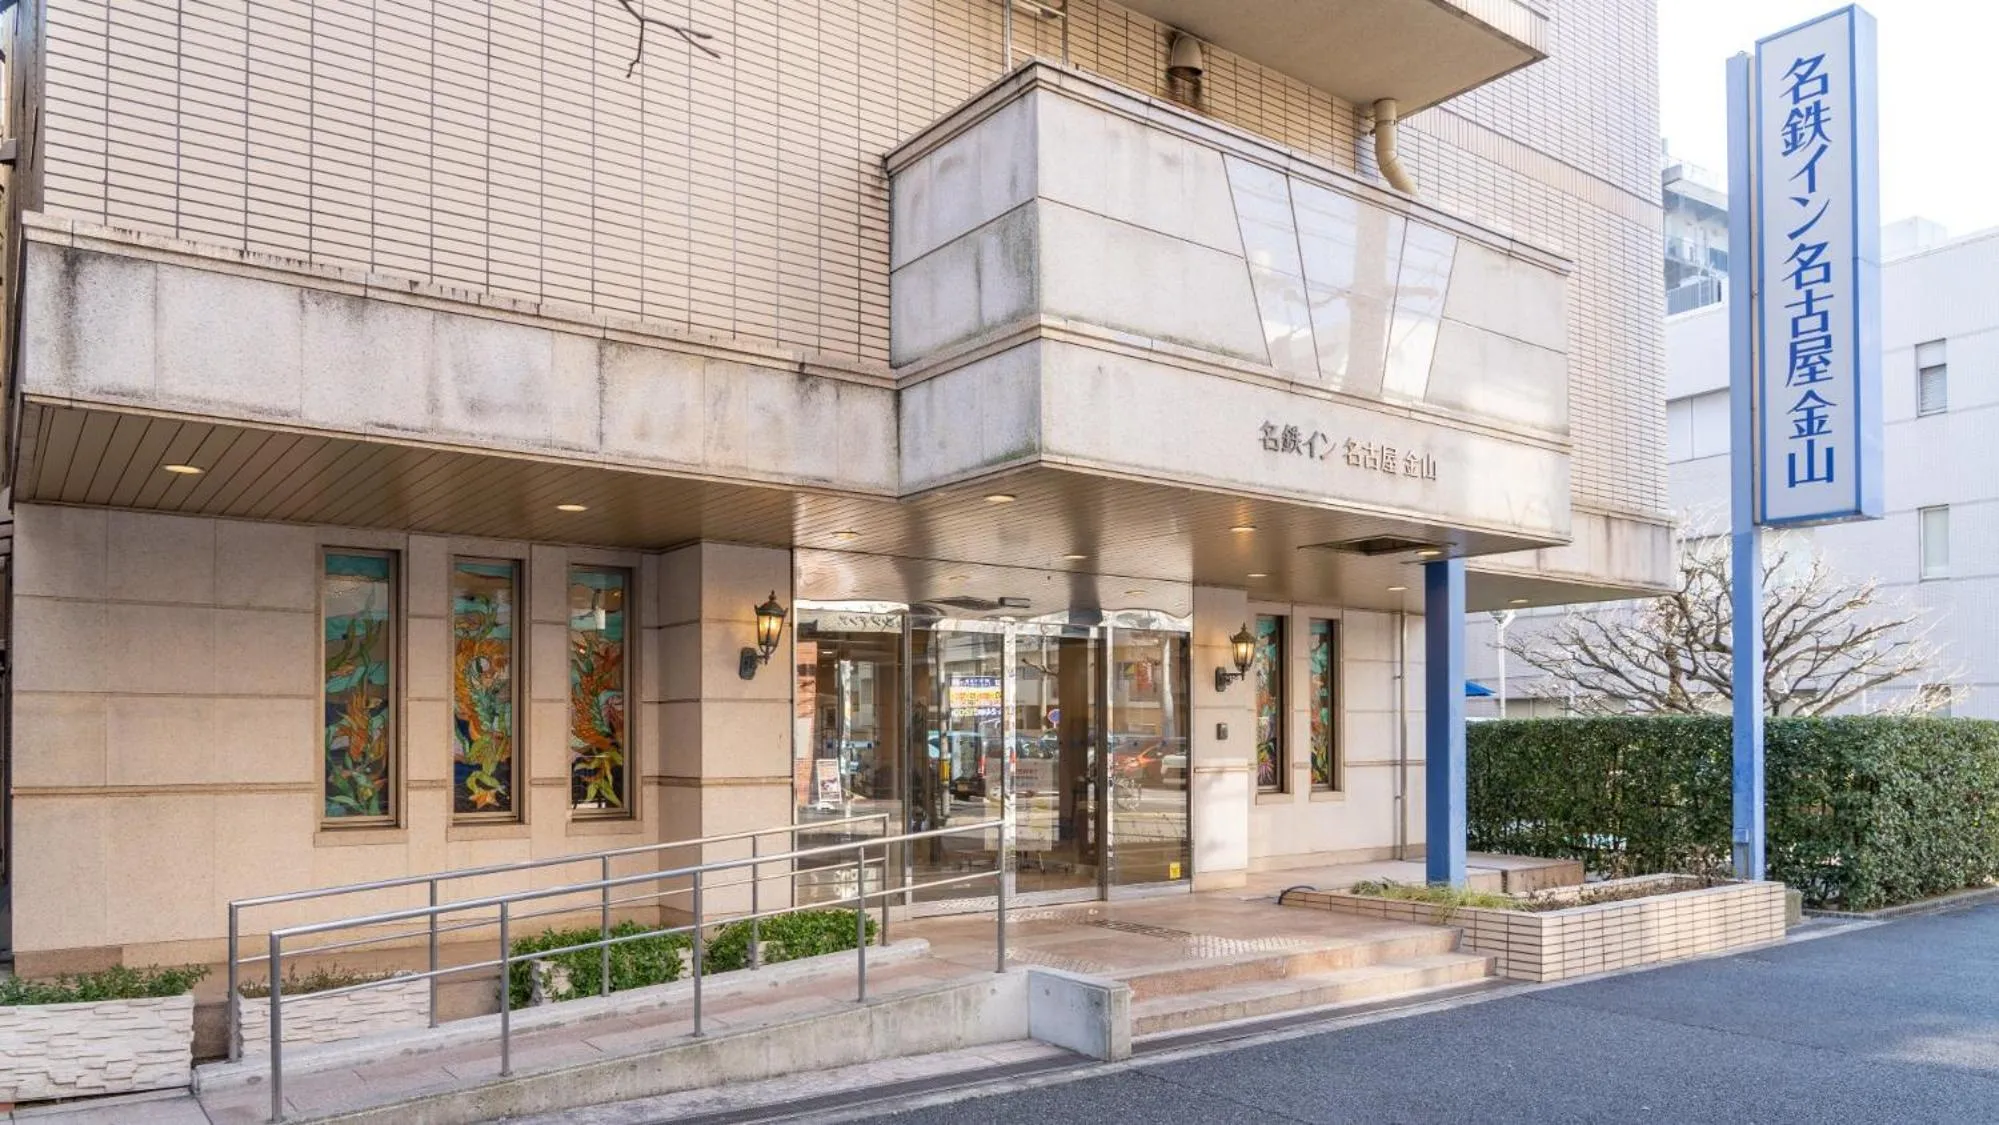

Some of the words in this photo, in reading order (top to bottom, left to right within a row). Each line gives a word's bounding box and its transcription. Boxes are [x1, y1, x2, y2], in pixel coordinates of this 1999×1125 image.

[1780, 53, 1836, 488] 名鉄イン名古屋金山
